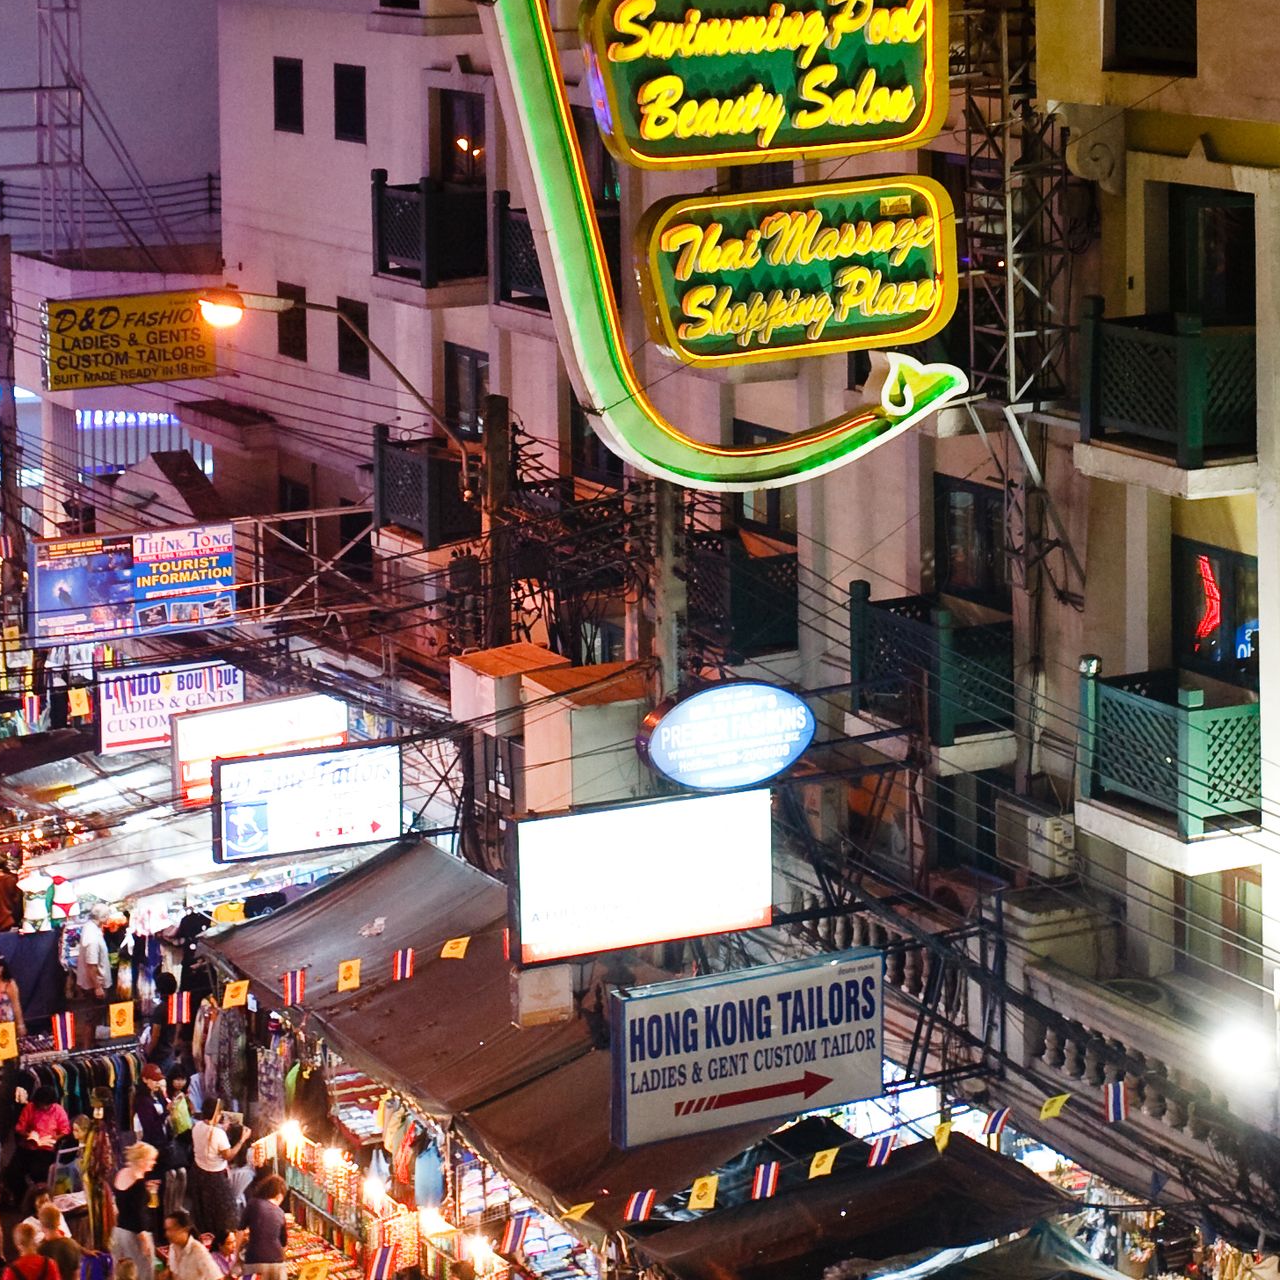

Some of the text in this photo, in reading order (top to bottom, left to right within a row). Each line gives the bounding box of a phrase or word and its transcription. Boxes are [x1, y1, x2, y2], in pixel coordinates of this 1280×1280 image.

[637, 65, 916, 147] Beauty Salon
[659, 209, 937, 281] Thai Massage
[678, 265, 945, 347] Shopping Plaza
[54, 306, 120, 334] D&D
[61, 327, 201, 352] LADIES & GENTS
[56, 345, 206, 370] CUSTOM TAILORS
[54, 374, 79, 385] SUIT
[84, 370, 117, 382] MADE
[121, 367, 159, 380] READY
[176, 363, 188, 375] 18
[136, 566, 232, 588] INFORMATION
[149, 556, 220, 574] TOURIST
[112, 688, 234, 715] LADIES & GENTS
[629, 975, 876, 1063] HONG KONG TAILORS
[630, 1027, 877, 1095] LADIES & GENT CUSTOM TAILOR
